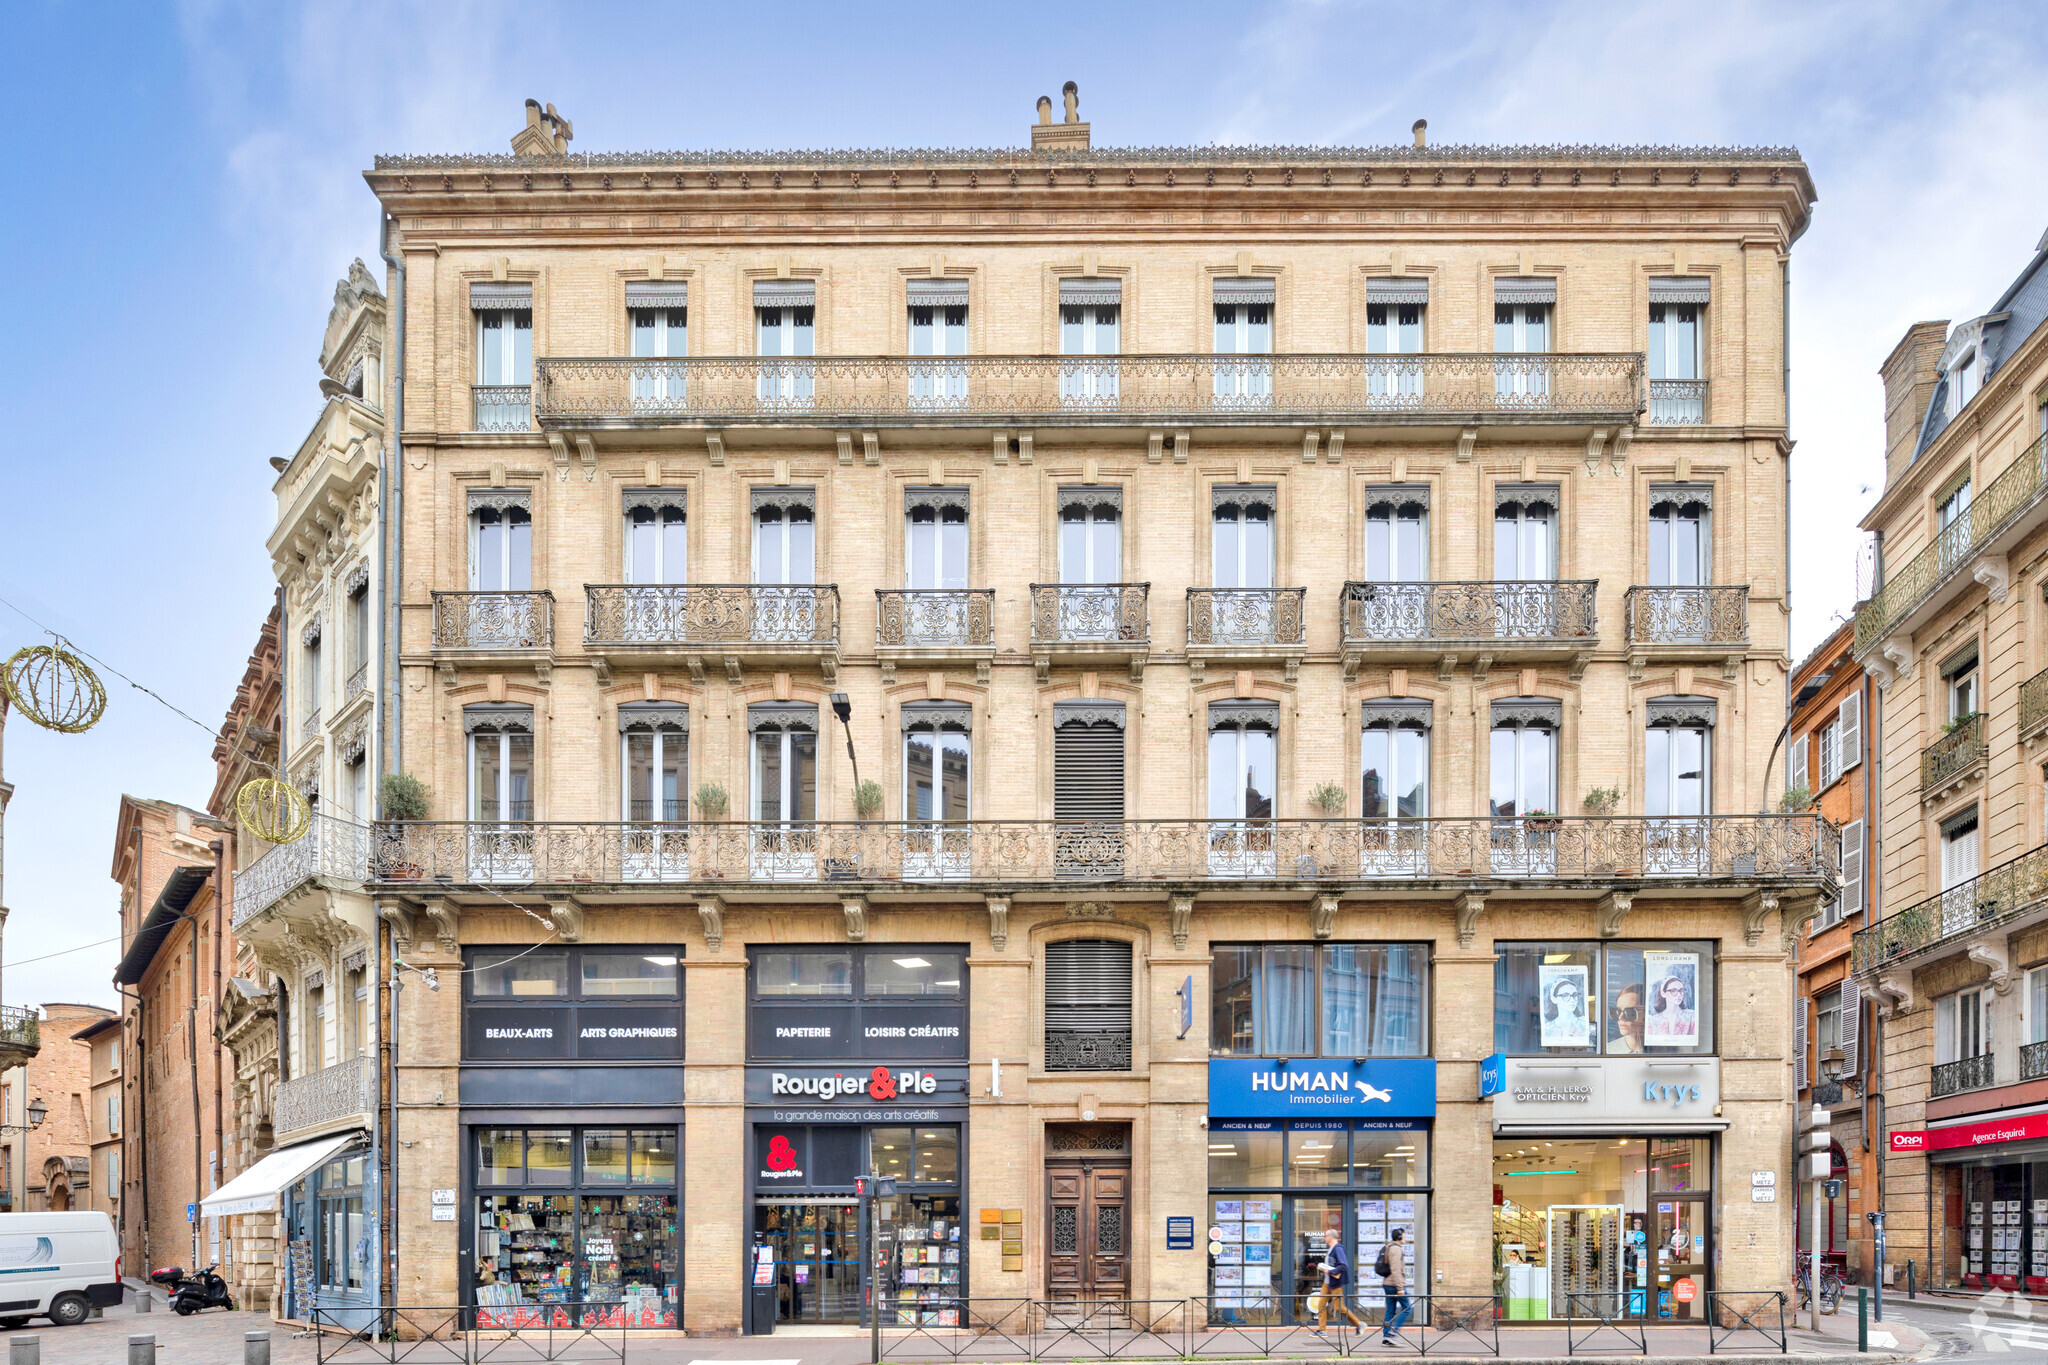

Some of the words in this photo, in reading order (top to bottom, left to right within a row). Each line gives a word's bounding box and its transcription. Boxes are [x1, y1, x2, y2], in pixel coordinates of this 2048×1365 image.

[486, 1028, 553, 1038] BEAUX-ARTS
[580, 1028, 608, 1038] ARTS
[608, 1028, 678, 1038] GRAPHIQUES
[776, 1028, 831, 1038] PAPETERIE
[864, 1027, 906, 1038] LOISIRS
[908, 1024, 960, 1037] CRÉATIFS
[1482, 1069, 1497, 1082] Krys
[772, 1072, 868, 1100] Rougier
[869, 1066, 897, 1100] &
[900, 1071, 937, 1094] Plé
[1252, 1072, 1348, 1092] HUMAN
[1290, 1094, 1356, 1104] Immobilier
[1570, 1094, 1591, 1102] Krys
[1644, 1080, 1701, 1106] Krys
[774, 1110, 784, 1120] la
[786, 1110, 822, 1122] grande
[825, 1110, 862, 1120] maison
[863, 1110, 882, 1120] des
[884, 1110, 902, 1120] arts
[904, 1110, 939, 1120] créatifs
[1894, 1135, 1922, 1144] ORPI
[1972, 1134, 1996, 1144] Agence
[1998, 1127, 2026, 1141] Esquirol
[766, 1135, 798, 1170] &
[586, 1244, 614, 1254] Noël
